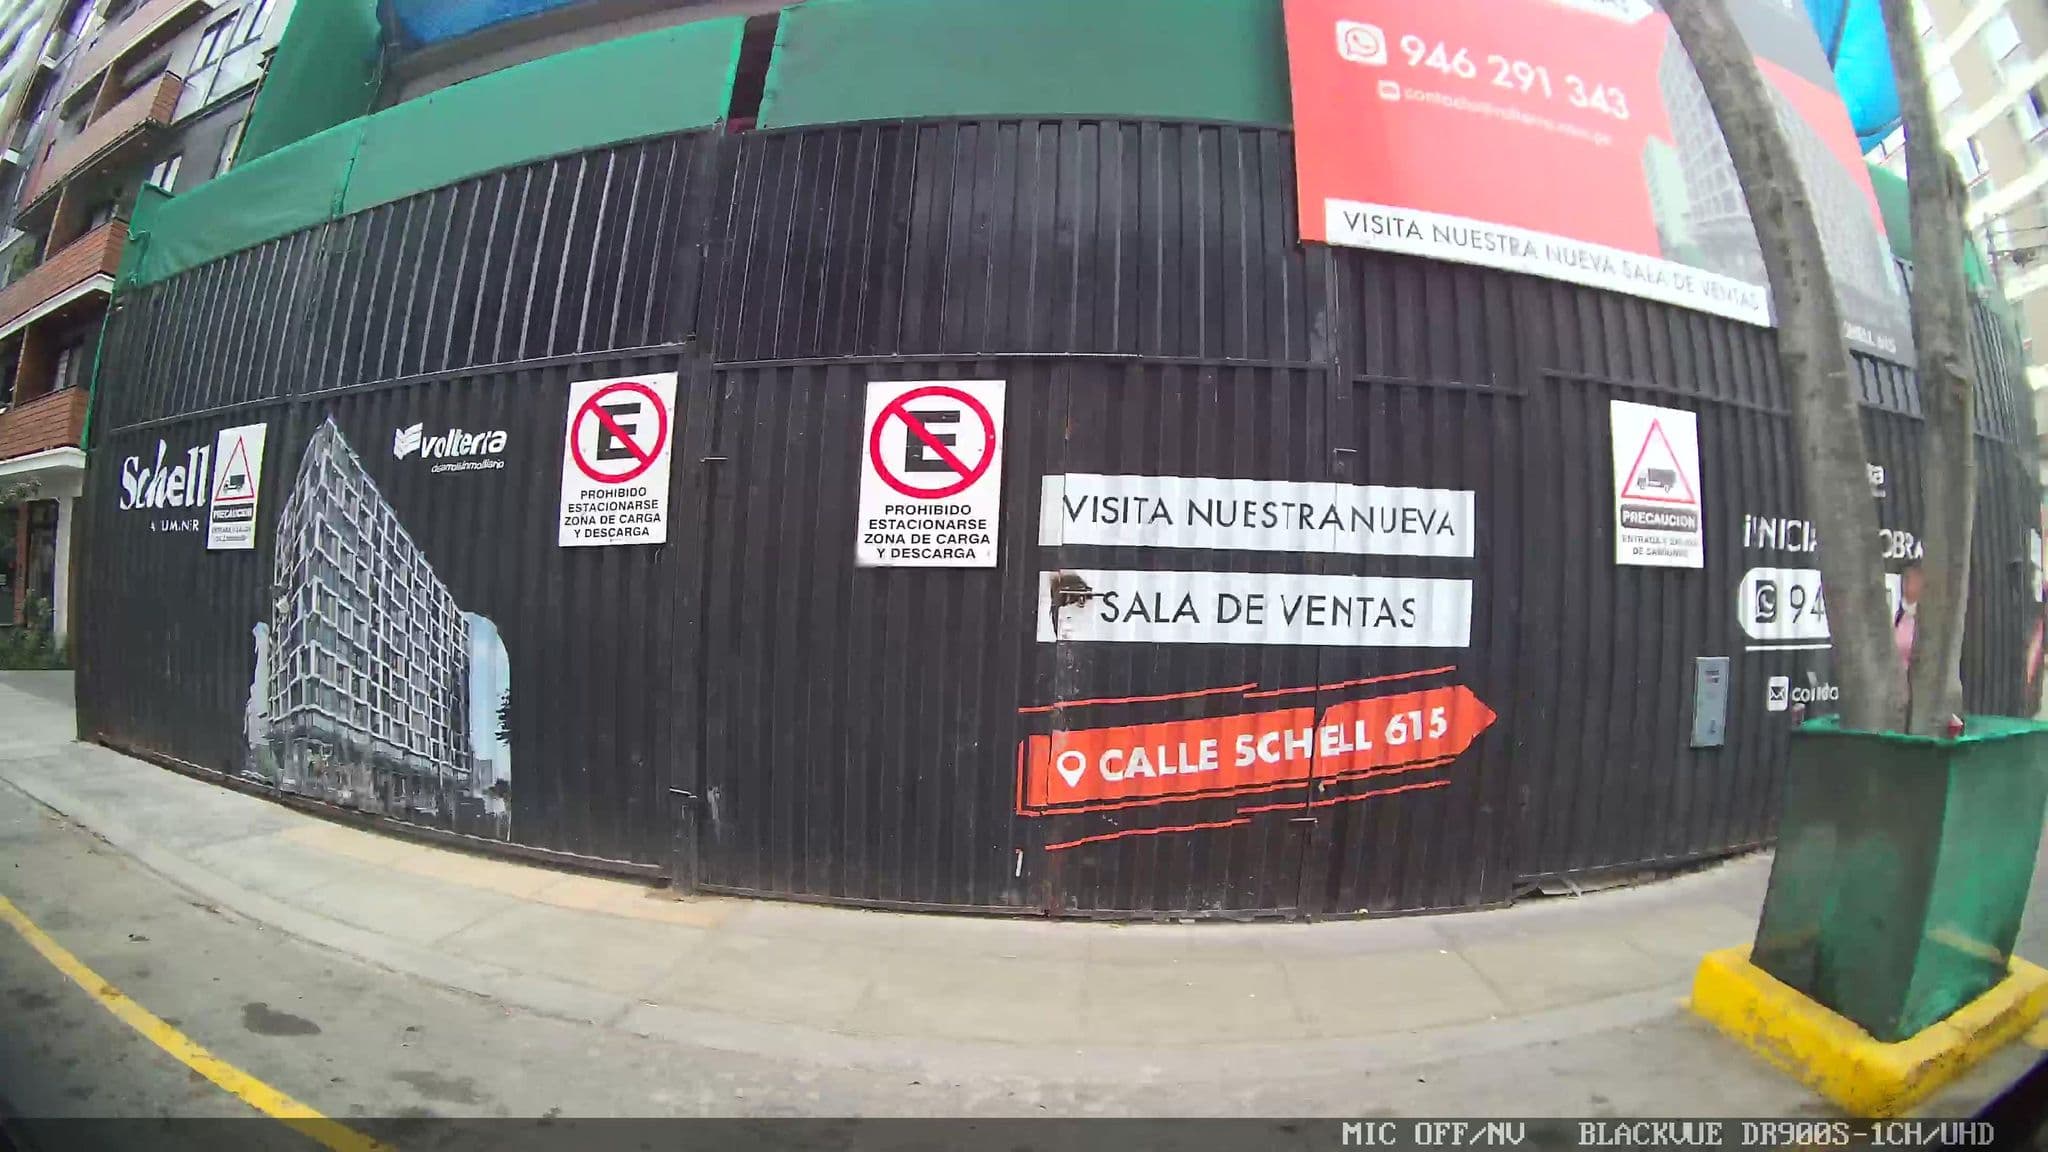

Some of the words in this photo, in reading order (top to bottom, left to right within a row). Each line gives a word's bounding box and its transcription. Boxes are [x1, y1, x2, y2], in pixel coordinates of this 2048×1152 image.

[1400, 35, 1477, 79] 946
[1487, 55, 1552, 99] 291
[1565, 75, 1630, 120] 343
[1344, 211, 1423, 240] VISITA
[1433, 224, 1538, 259] NUESTRA
[1545, 244, 1616, 275] NUEVA
[1622, 260, 1666, 287] SALA
[1673, 273, 1695, 293] DE
[120, 439, 210, 510] Schell
[581, 487, 647, 499] PROHIBIDO
[568, 499, 659, 512] ESTACIONARSE
[885, 505, 972, 515] PROHIBIDO
[564, 515, 596, 526] ZONA
[600, 515, 616, 524] DE
[619, 513, 661, 523] CARGA
[1063, 495, 1173, 526] VISITA
[1188, 498, 1344, 531] NUESTRA
[1351, 505, 1455, 536] NUEVA
[869, 519, 987, 530] ESTACIONARSE
[574, 529, 581, 538] Y
[585, 527, 649, 538] DESCARGA
[864, 533, 905, 544] ZONA
[911, 533, 931, 544] DE
[936, 533, 990, 544] CARGA
[877, 548, 885, 558] Y
[891, 548, 976, 558] DESCARGA
[1100, 590, 1200, 624] SALA
[1217, 593, 1265, 625] DE
[1280, 594, 1416, 628] VENTAS
[1099, 738, 1218, 781] CALLE
[1235, 719, 1372, 767] SCHELL
[1386, 706, 1448, 746] 615
